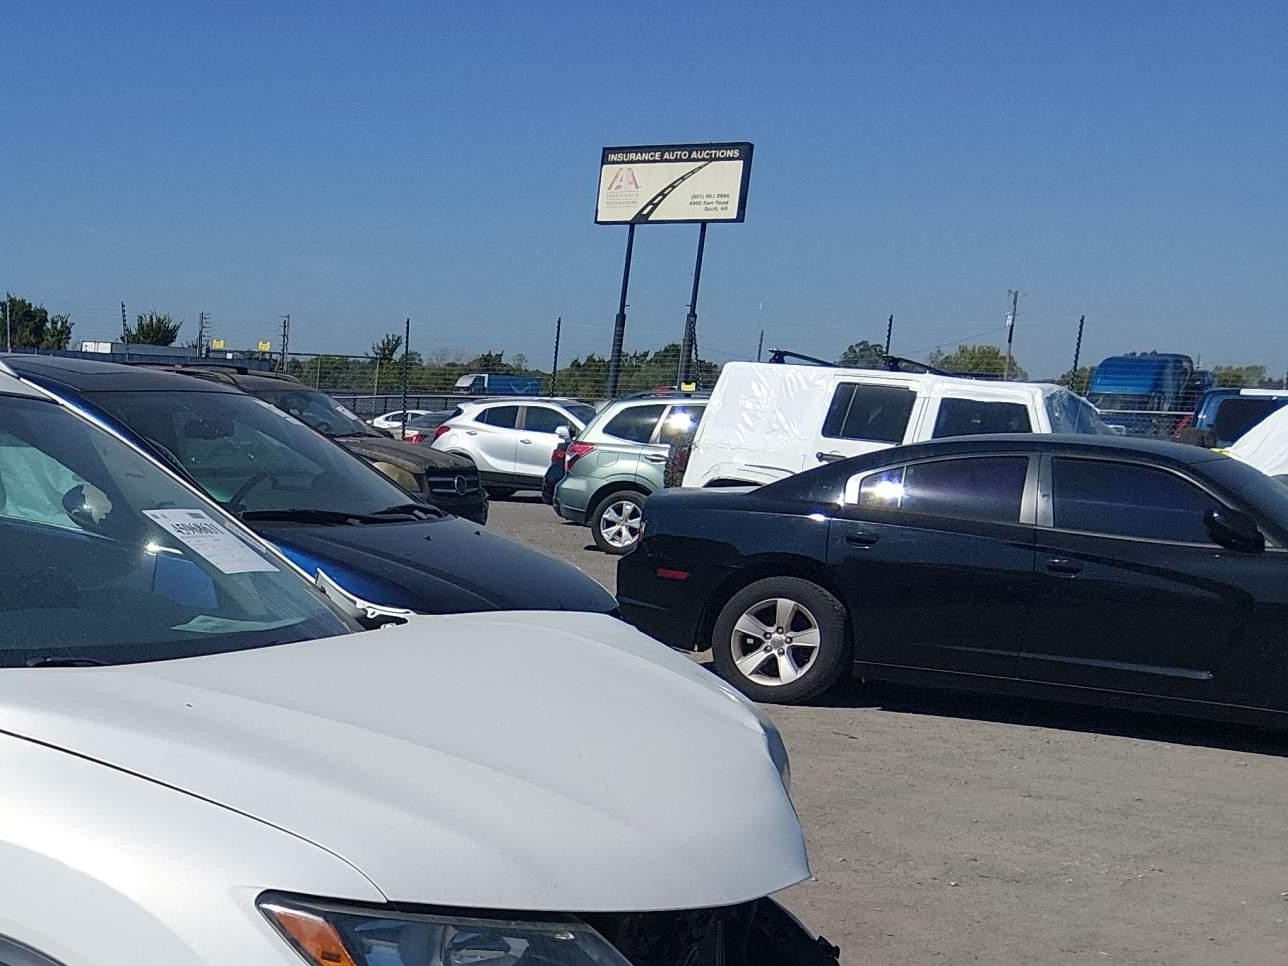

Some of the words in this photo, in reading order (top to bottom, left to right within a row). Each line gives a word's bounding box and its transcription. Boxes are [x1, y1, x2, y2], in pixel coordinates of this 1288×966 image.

[607, 152, 661, 162] INSURANCE
[663, 151, 689, 160] AUTO
[691, 149, 740, 159] AUCTIONS
